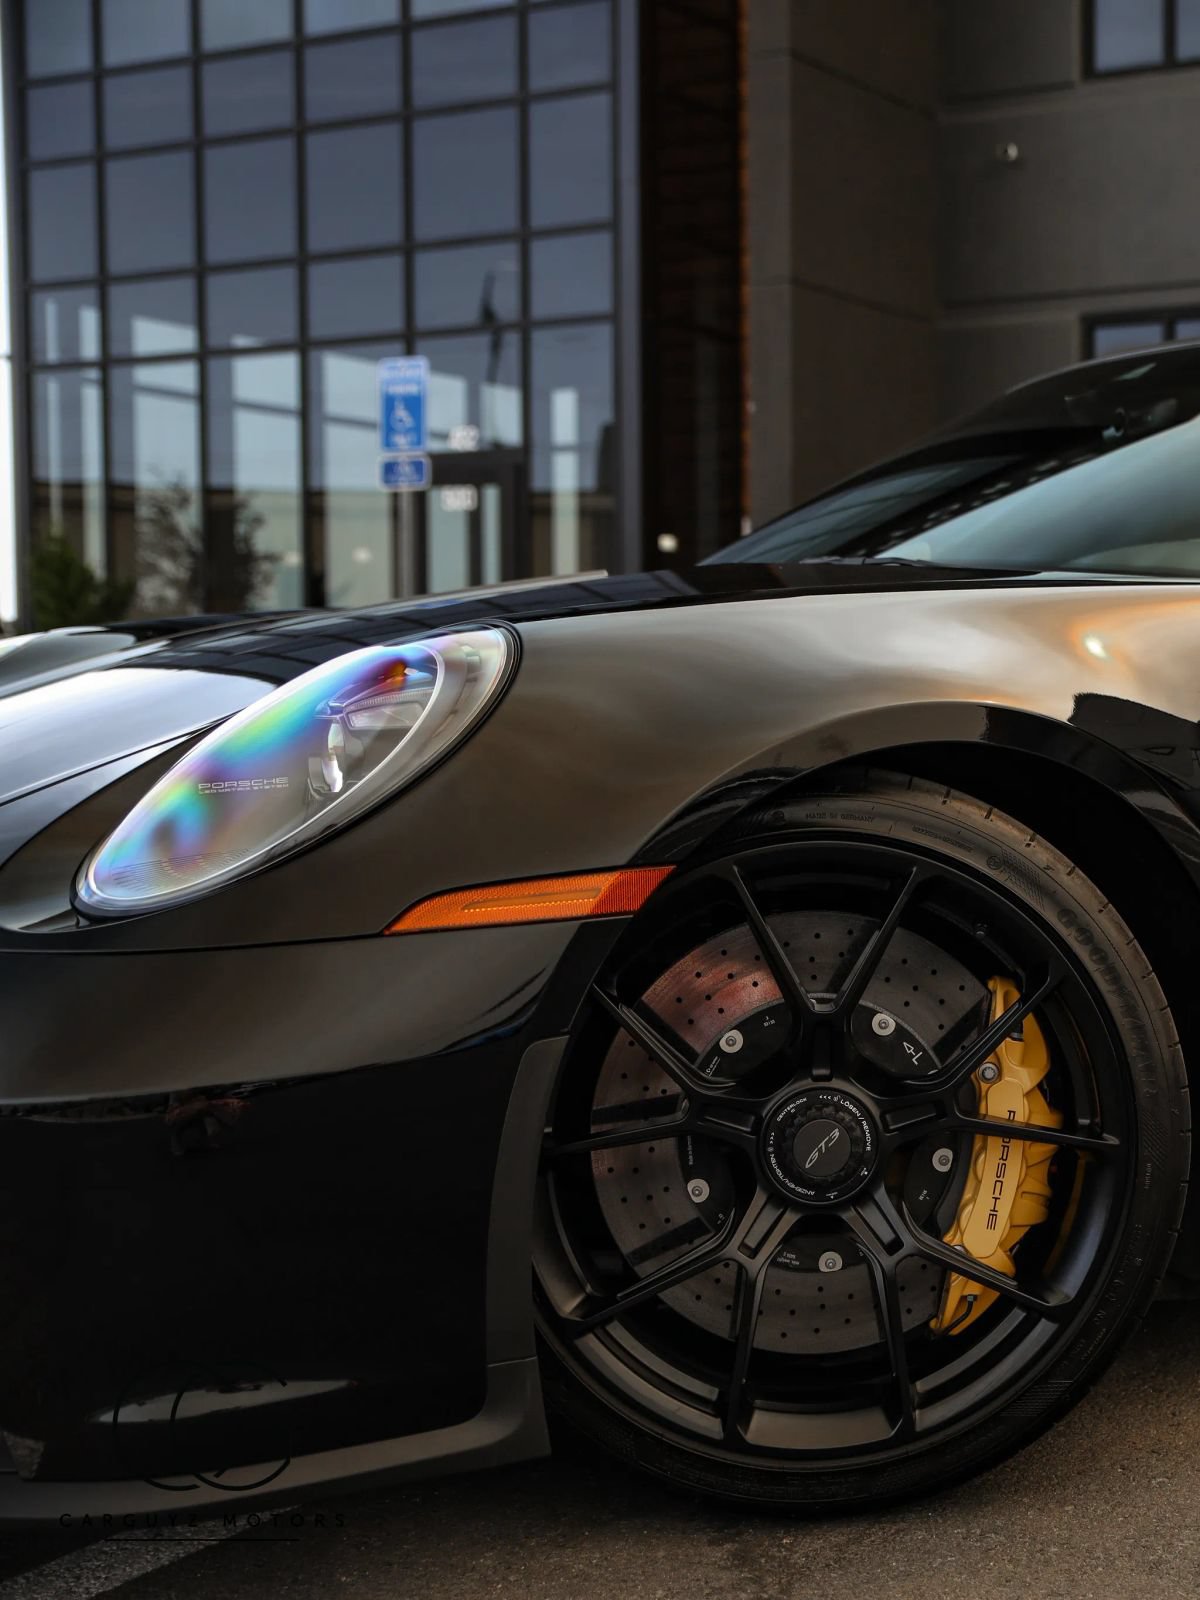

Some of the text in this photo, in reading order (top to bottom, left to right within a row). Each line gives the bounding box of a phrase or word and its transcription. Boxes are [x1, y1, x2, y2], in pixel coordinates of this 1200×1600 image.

[198, 776, 289, 790] PORSCHE
[840, 813, 874, 823] GERMANY
[776, 1097, 808, 1122] CENTERLOCK
[804, 1127, 840, 1169] GT3
[860, 1119, 872, 1152] REMOVE
